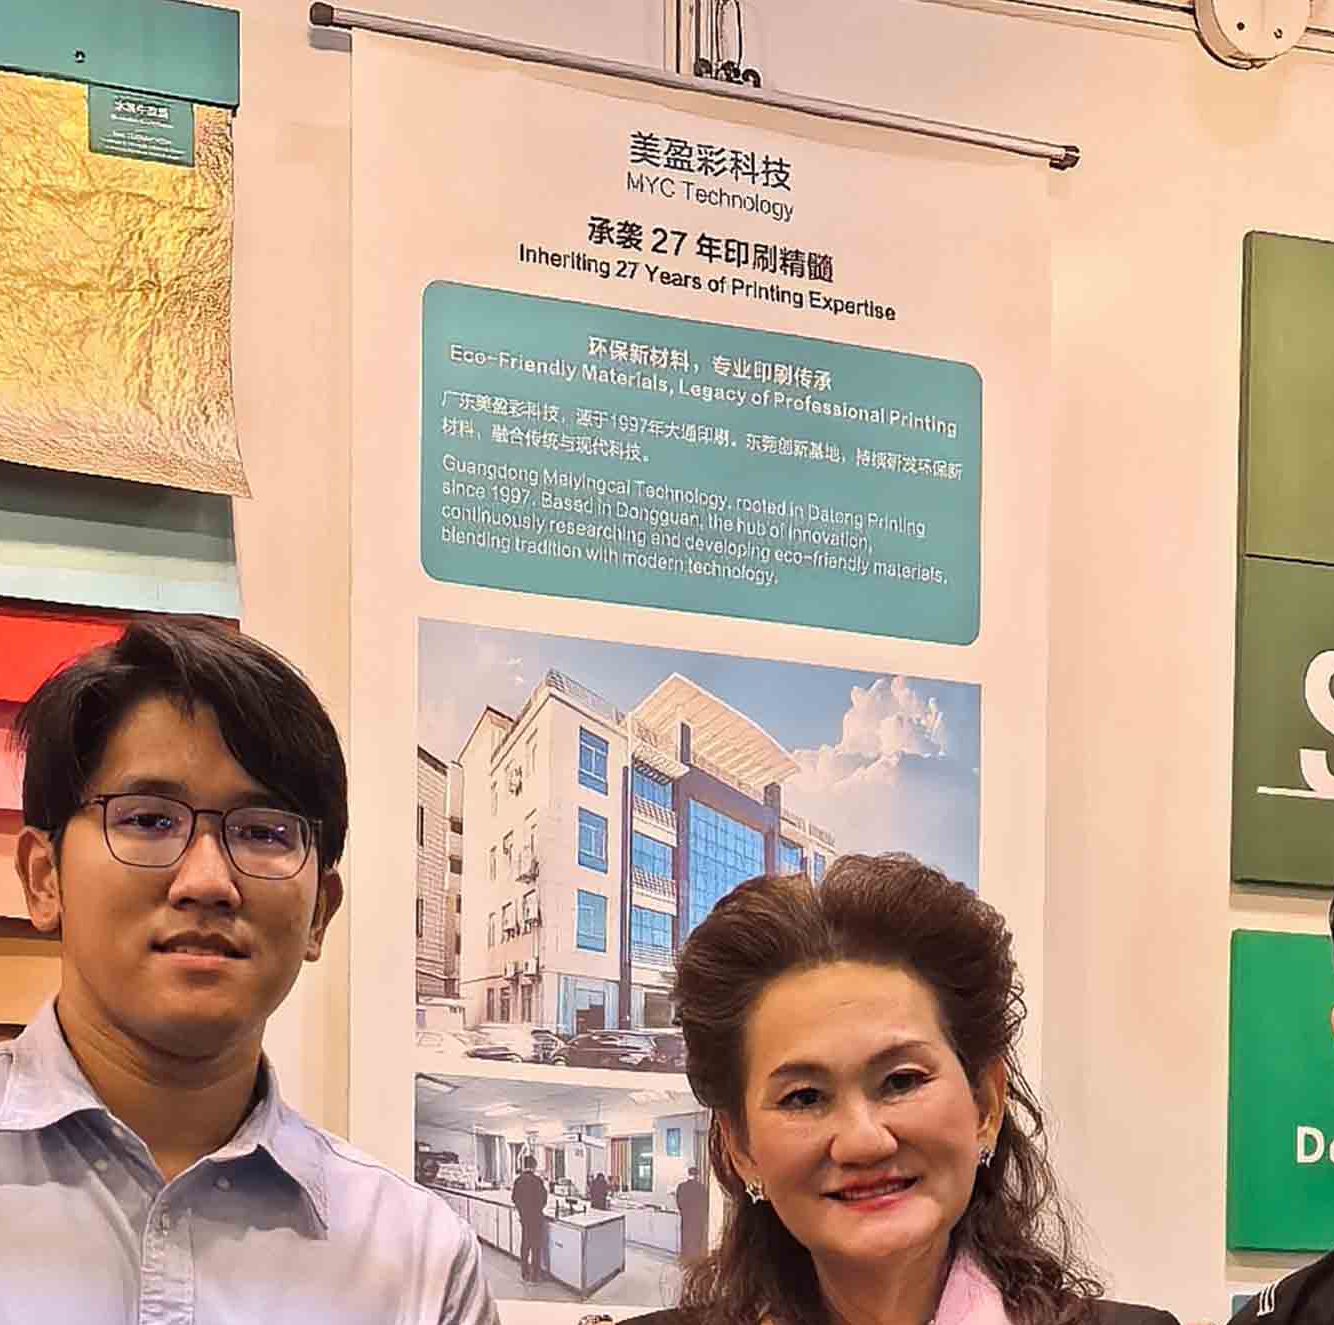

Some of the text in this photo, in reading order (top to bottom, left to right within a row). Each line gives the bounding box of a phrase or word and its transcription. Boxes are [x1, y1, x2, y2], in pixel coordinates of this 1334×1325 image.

[630, 131, 792, 191] 美盈彩科技
[627, 172, 794, 223] MYC Technology
[519, 243, 897, 321] Inheriting 27 Years of Printing Expertise
[587, 216, 834, 283] 承袭 27 年印刷精髓
[450, 344, 957, 438] Eco-Friendly Materials, Legacy of Professional Printing
[442, 454, 539, 485] Guangdong
[736, 497, 786, 516] rooted
[790, 503, 804, 519] in
[868, 512, 926, 538] Printing
[442, 479, 485, 499] since
[541, 491, 593, 513] Based
[597, 500, 612, 516] in
[708, 514, 733, 532] the
[737, 517, 766, 536] hub
[769, 522, 786, 538] of
[441, 504, 545, 534] continuously
[549, 518, 647, 548] researching
[651, 529, 682, 549] and
[685, 533, 771, 562] developing
[774, 549, 869, 576] eco-friendly
[442, 527, 511, 554] blending
[515, 534, 582, 560] tradition
[586, 547, 618, 564] with
[622, 550, 684, 573] modern
